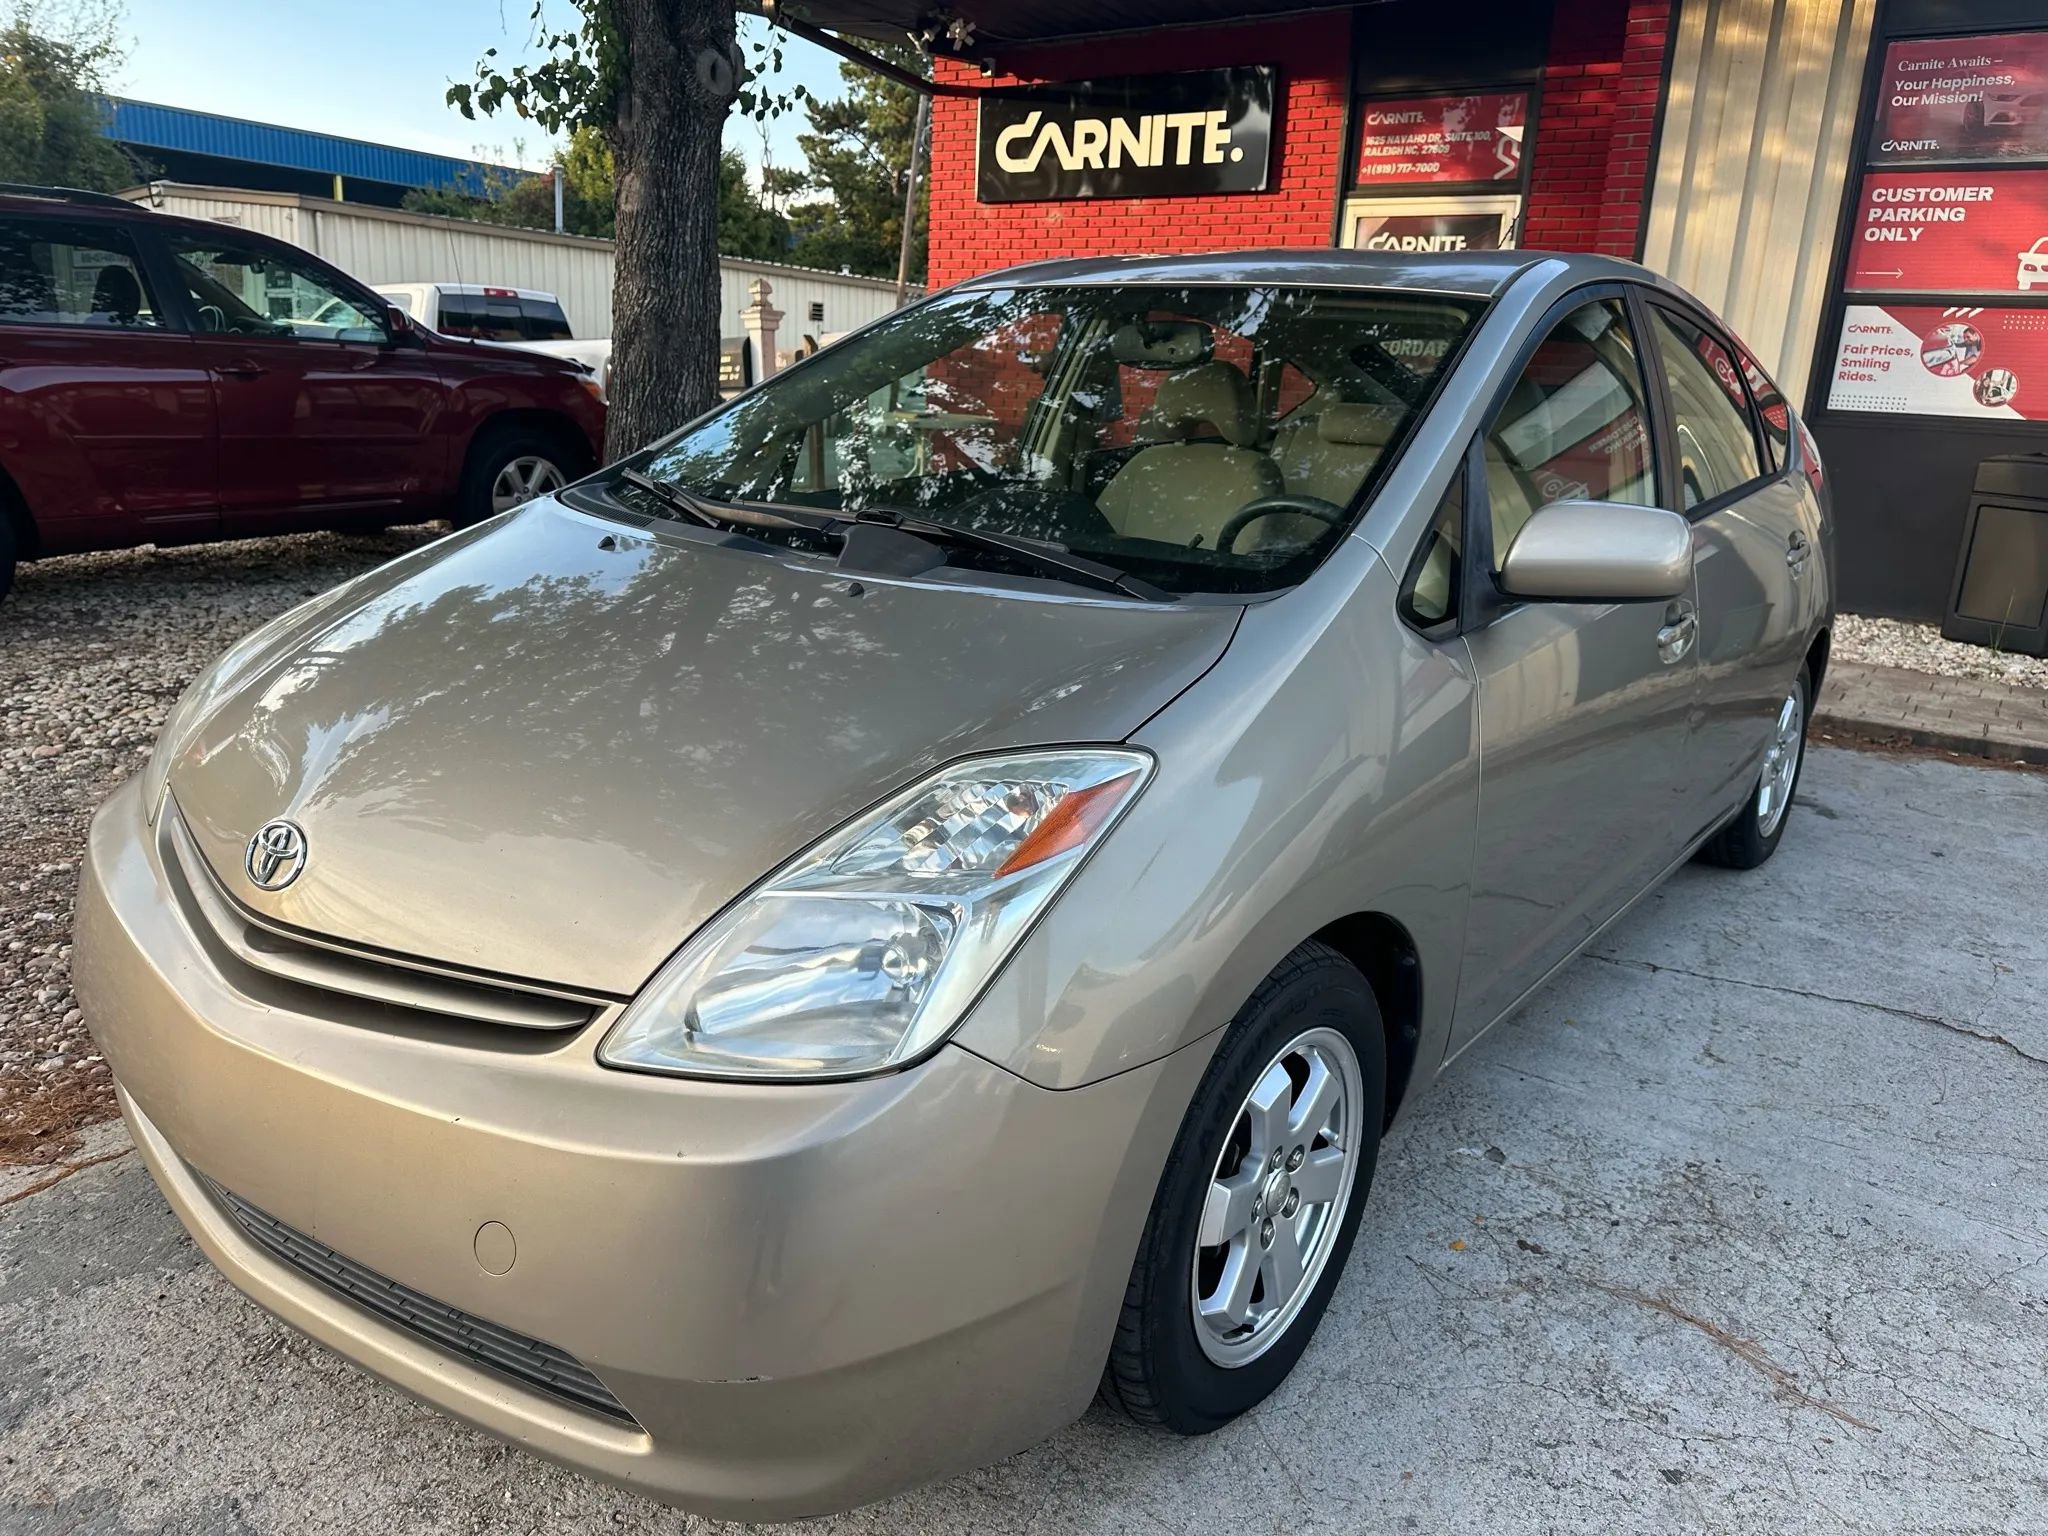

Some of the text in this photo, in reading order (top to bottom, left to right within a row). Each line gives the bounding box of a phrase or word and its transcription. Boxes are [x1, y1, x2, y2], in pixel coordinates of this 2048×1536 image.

[1898, 59, 1945, 72] Carnite
[1947, 55, 1992, 69] Awaits
[1895, 74, 2016, 92] Your Happiness,
[1891, 91, 1984, 107] Our Mission!
[995, 110, 1244, 174] CARNITE.
[1386, 134, 1427, 145] NAVAHO
[1363, 146, 1404, 157] RALEIGH
[1871, 186, 1995, 203] CUSTOMER
[1867, 206, 1967, 222] PARKING
[1367, 231, 1469, 252] CARNITE
[1863, 227, 1925, 242] ONLY
[1843, 344, 1914, 358] Fair Prices,
[1840, 357, 1891, 372] Smiling
[1838, 370, 1877, 382] Rides.
